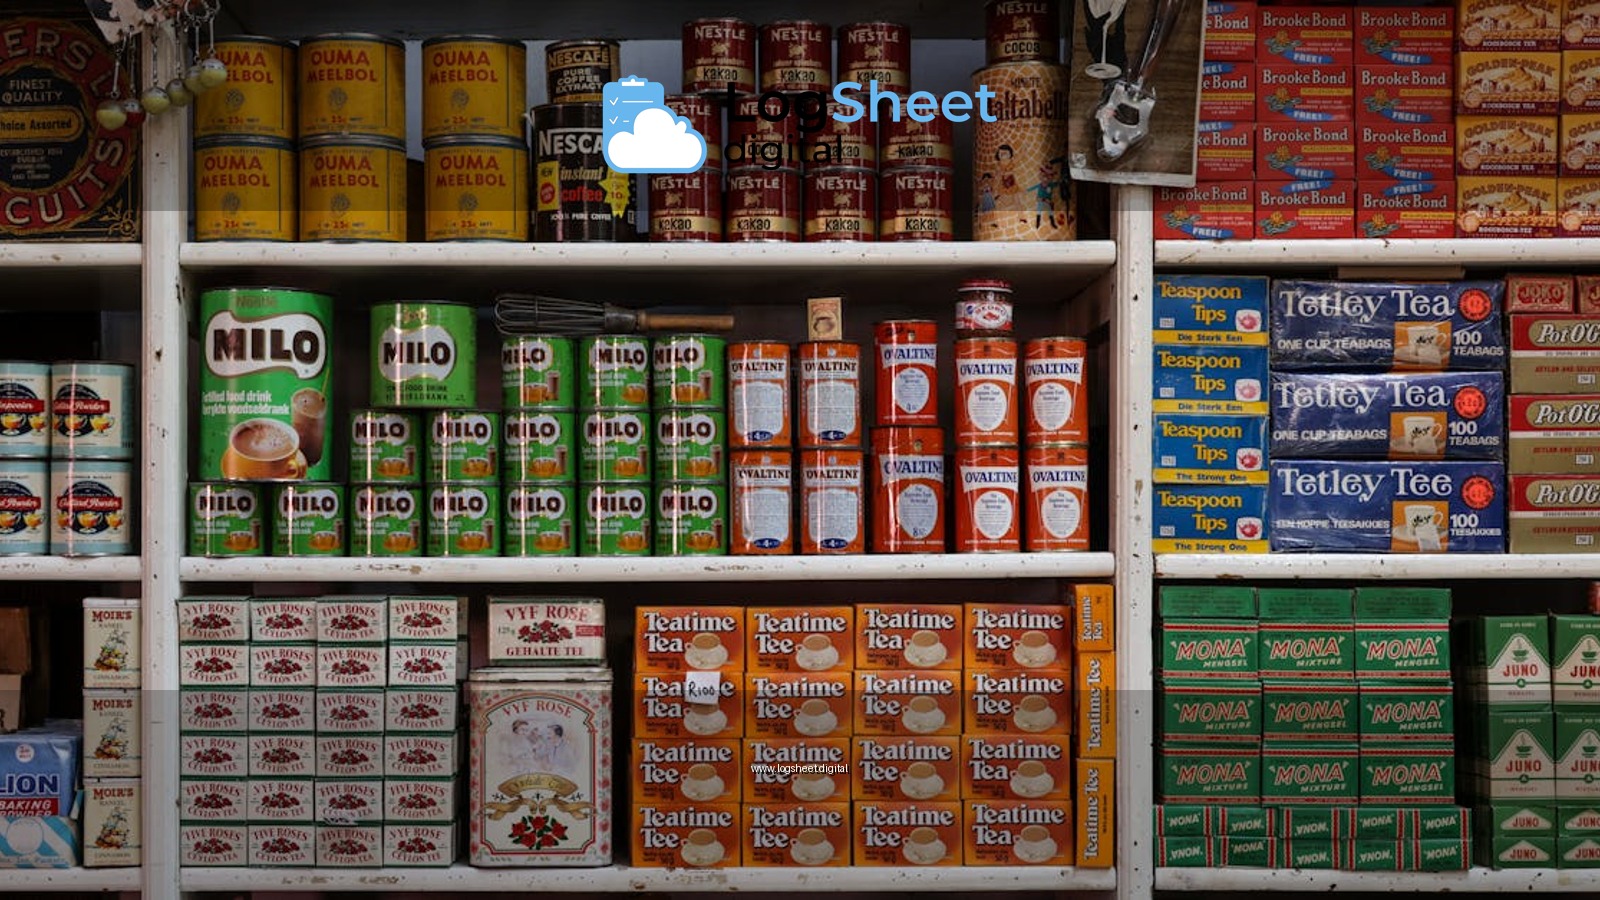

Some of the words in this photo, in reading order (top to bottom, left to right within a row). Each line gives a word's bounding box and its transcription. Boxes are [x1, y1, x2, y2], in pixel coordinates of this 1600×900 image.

[1263, 12, 1310, 27] Brooke
[1313, 12, 1346, 27] Bond
[311, 50, 370, 66] OUMA
[433, 50, 490, 66] OUMA
[306, 68, 377, 82] MEELBOL
[429, 69, 498, 84] MEELBOL
[557, 75, 600, 86] COFFEE
[563, 68, 591, 77] PURE
[703, 67, 738, 81] kakao
[857, 70, 891, 83] kakao
[1362, 70, 1409, 85] Brooke
[1412, 70, 1446, 86] Bond
[10, 79, 51, 90] FINEST
[556, 83, 602, 93] EXTRACT
[2, 91, 62, 103] QUALITY
[30, 117, 72, 130] Assorted
[1263, 128, 1311, 143] Brooke
[1313, 127, 1349, 142] Bond
[204, 155, 262, 170] OUMA
[440, 155, 500, 171] OUMA
[201, 174, 270, 188] MEELBOL
[436, 173, 506, 188] MEELBOL
[560, 167, 603, 181] instant
[561, 186, 603, 202] coffee
[1161, 187, 1210, 201] Brooke
[1212, 187, 1247, 201] Bond
[1261, 191, 1311, 206] Brooke
[1312, 191, 1346, 205] Bond
[658, 218, 692, 231] kakao
[905, 218, 939, 231] kakao
[1158, 281, 1242, 300] Teaspoon
[1280, 290, 1386, 323] Tetley
[1391, 289, 1455, 317] Tea
[1191, 304, 1227, 325] Tips
[1453, 331, 1482, 345] 100
[1536, 323, 1569, 343] Pot
[213, 328, 320, 365] MILO
[1277, 339, 1303, 350] ONE
[1305, 339, 1331, 349] CUP
[1333, 339, 1392, 349] TEABAGS
[1453, 346, 1504, 356] TEABAGS
[383, 341, 451, 365] MILO
[598, 348, 645, 364] MILO
[884, 348, 936, 361] OVALTINE
[1157, 351, 1241, 370] Teaspoon
[731, 362, 785, 373] OVALTINE
[805, 362, 857, 373] OVALTINE
[960, 363, 1014, 376] OVALTINE
[1191, 375, 1226, 394] Tips
[1275, 383, 1379, 414] Tetley
[1386, 381, 1450, 407] Tea
[1535, 403, 1566, 424] Pot
[355, 422, 404, 439] MILO
[437, 422, 487, 439] MILO
[587, 422, 639, 438] MILO
[1450, 421, 1477, 435] 100
[1450, 436, 1499, 446] TEABAGS
[739, 469, 790, 480] OVALTINE
[965, 471, 1018, 484] OVALTINE
[1278, 468, 1385, 502] Tetley
[1391, 468, 1452, 496] Tee
[283, 495, 335, 513] MILO
[511, 496, 560, 513] MILO
[662, 496, 713, 513] MILO
[1157, 491, 1243, 512] Teaspoon
[1191, 514, 1228, 535] Tips
[1450, 514, 1478, 528] 100
[92, 610, 132, 622] MOIR'S
[505, 606, 539, 622] VYF
[546, 605, 590, 622] ROSE
[644, 611, 736, 632] Teatime
[754, 613, 846, 632] Teatime
[644, 633, 684, 653] Tea
[755, 634, 794, 653] Tee
[506, 647, 562, 656] GEHALTE
[566, 647, 585, 656] TEE
[1087, 658, 1100, 686] Tee
[1503, 664, 1538, 677] JUNO
[688, 681, 715, 697] R100
[861, 674, 953, 695] Teatime
[93, 699, 132, 710] MOIR'S
[502, 702, 530, 717] VYF
[536, 700, 573, 718] ROSE
[862, 696, 901, 716] Tee
[1087, 688, 1101, 750] Teatime
[639, 743, 732, 762] Teatime
[640, 764, 680, 784] Tee
[1506, 760, 1541, 772] JUNO
[94, 788, 133, 799] MOIR'S
[972, 805, 1065, 826] Teatime
[1512, 817, 1539, 827] JUNO
[973, 827, 1012, 846] Tea
